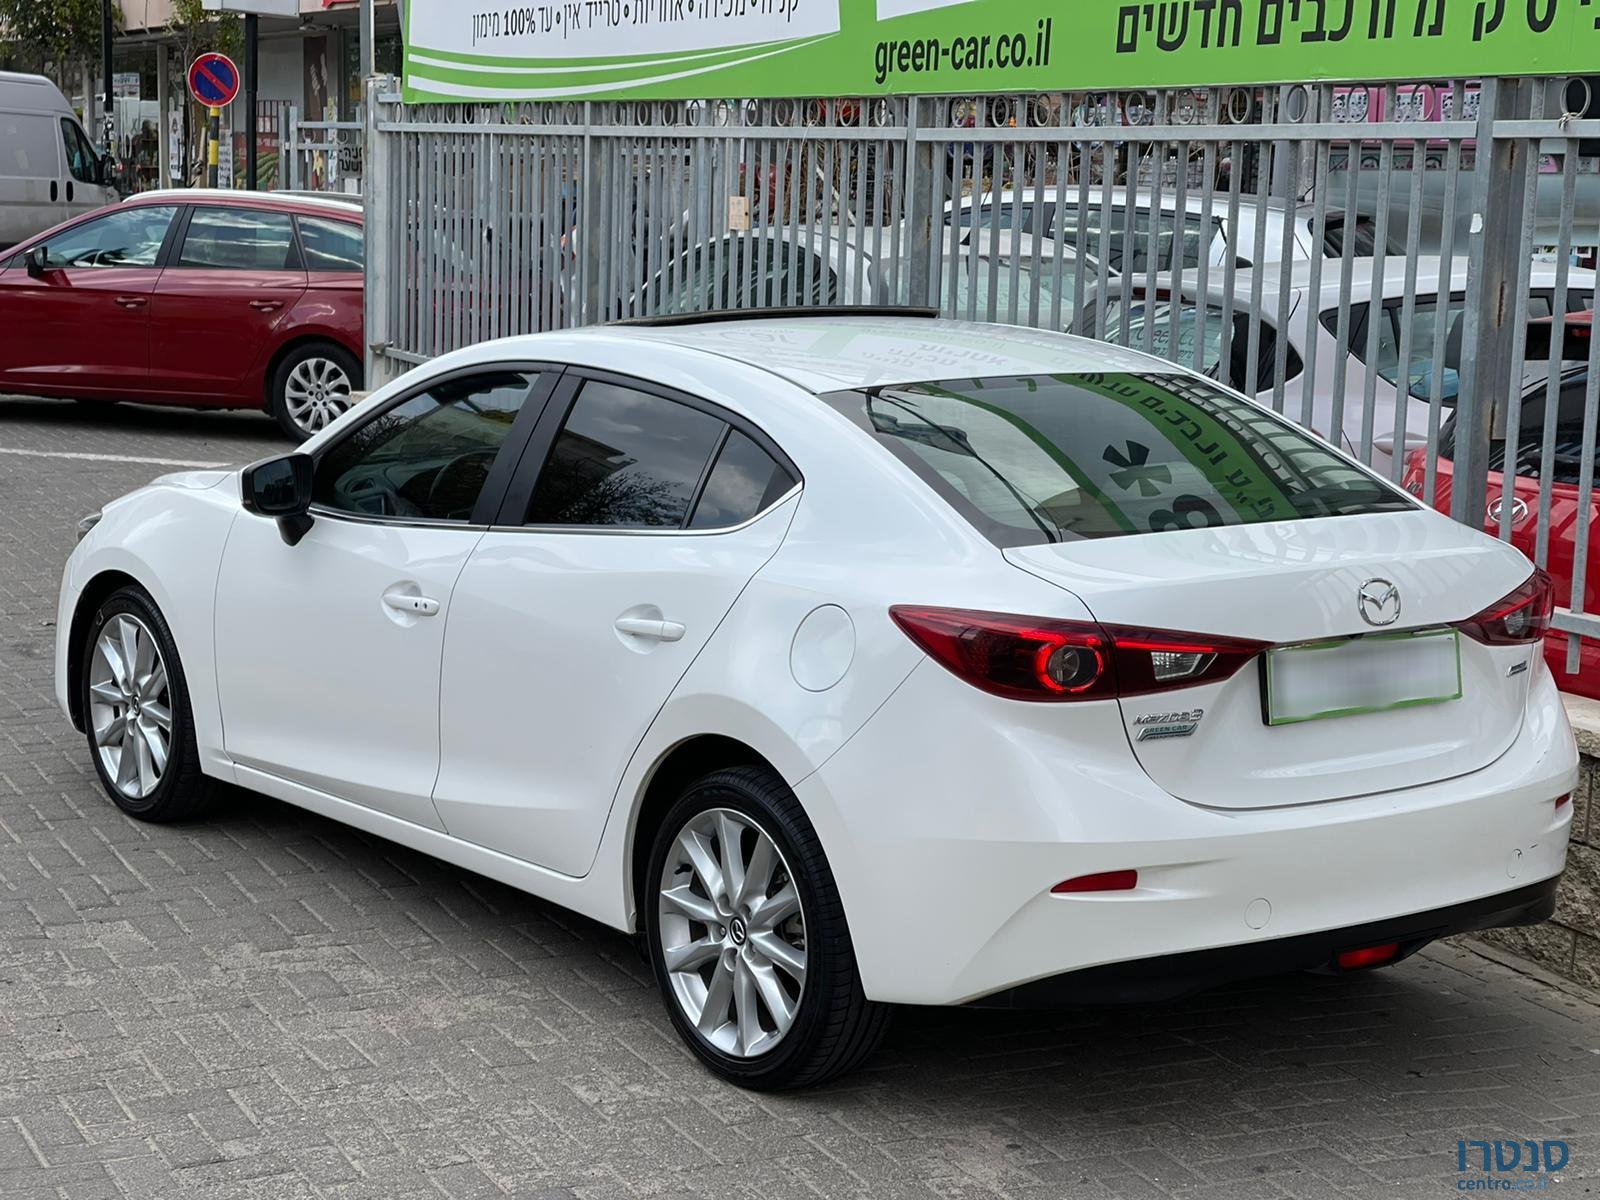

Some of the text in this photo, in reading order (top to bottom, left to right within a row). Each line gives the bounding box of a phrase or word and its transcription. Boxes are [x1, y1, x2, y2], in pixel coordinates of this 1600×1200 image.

[472, 12, 500, 47] מימון
[503, 8, 536, 36] 100%
[538, 7, 553, 33] עד
[563, 3, 582, 39] אין
[1115, 0, 1243, 53] חדשים
[874, 17, 1053, 85] green-car.co.il
[1144, 726, 1170, 734] GREEN
